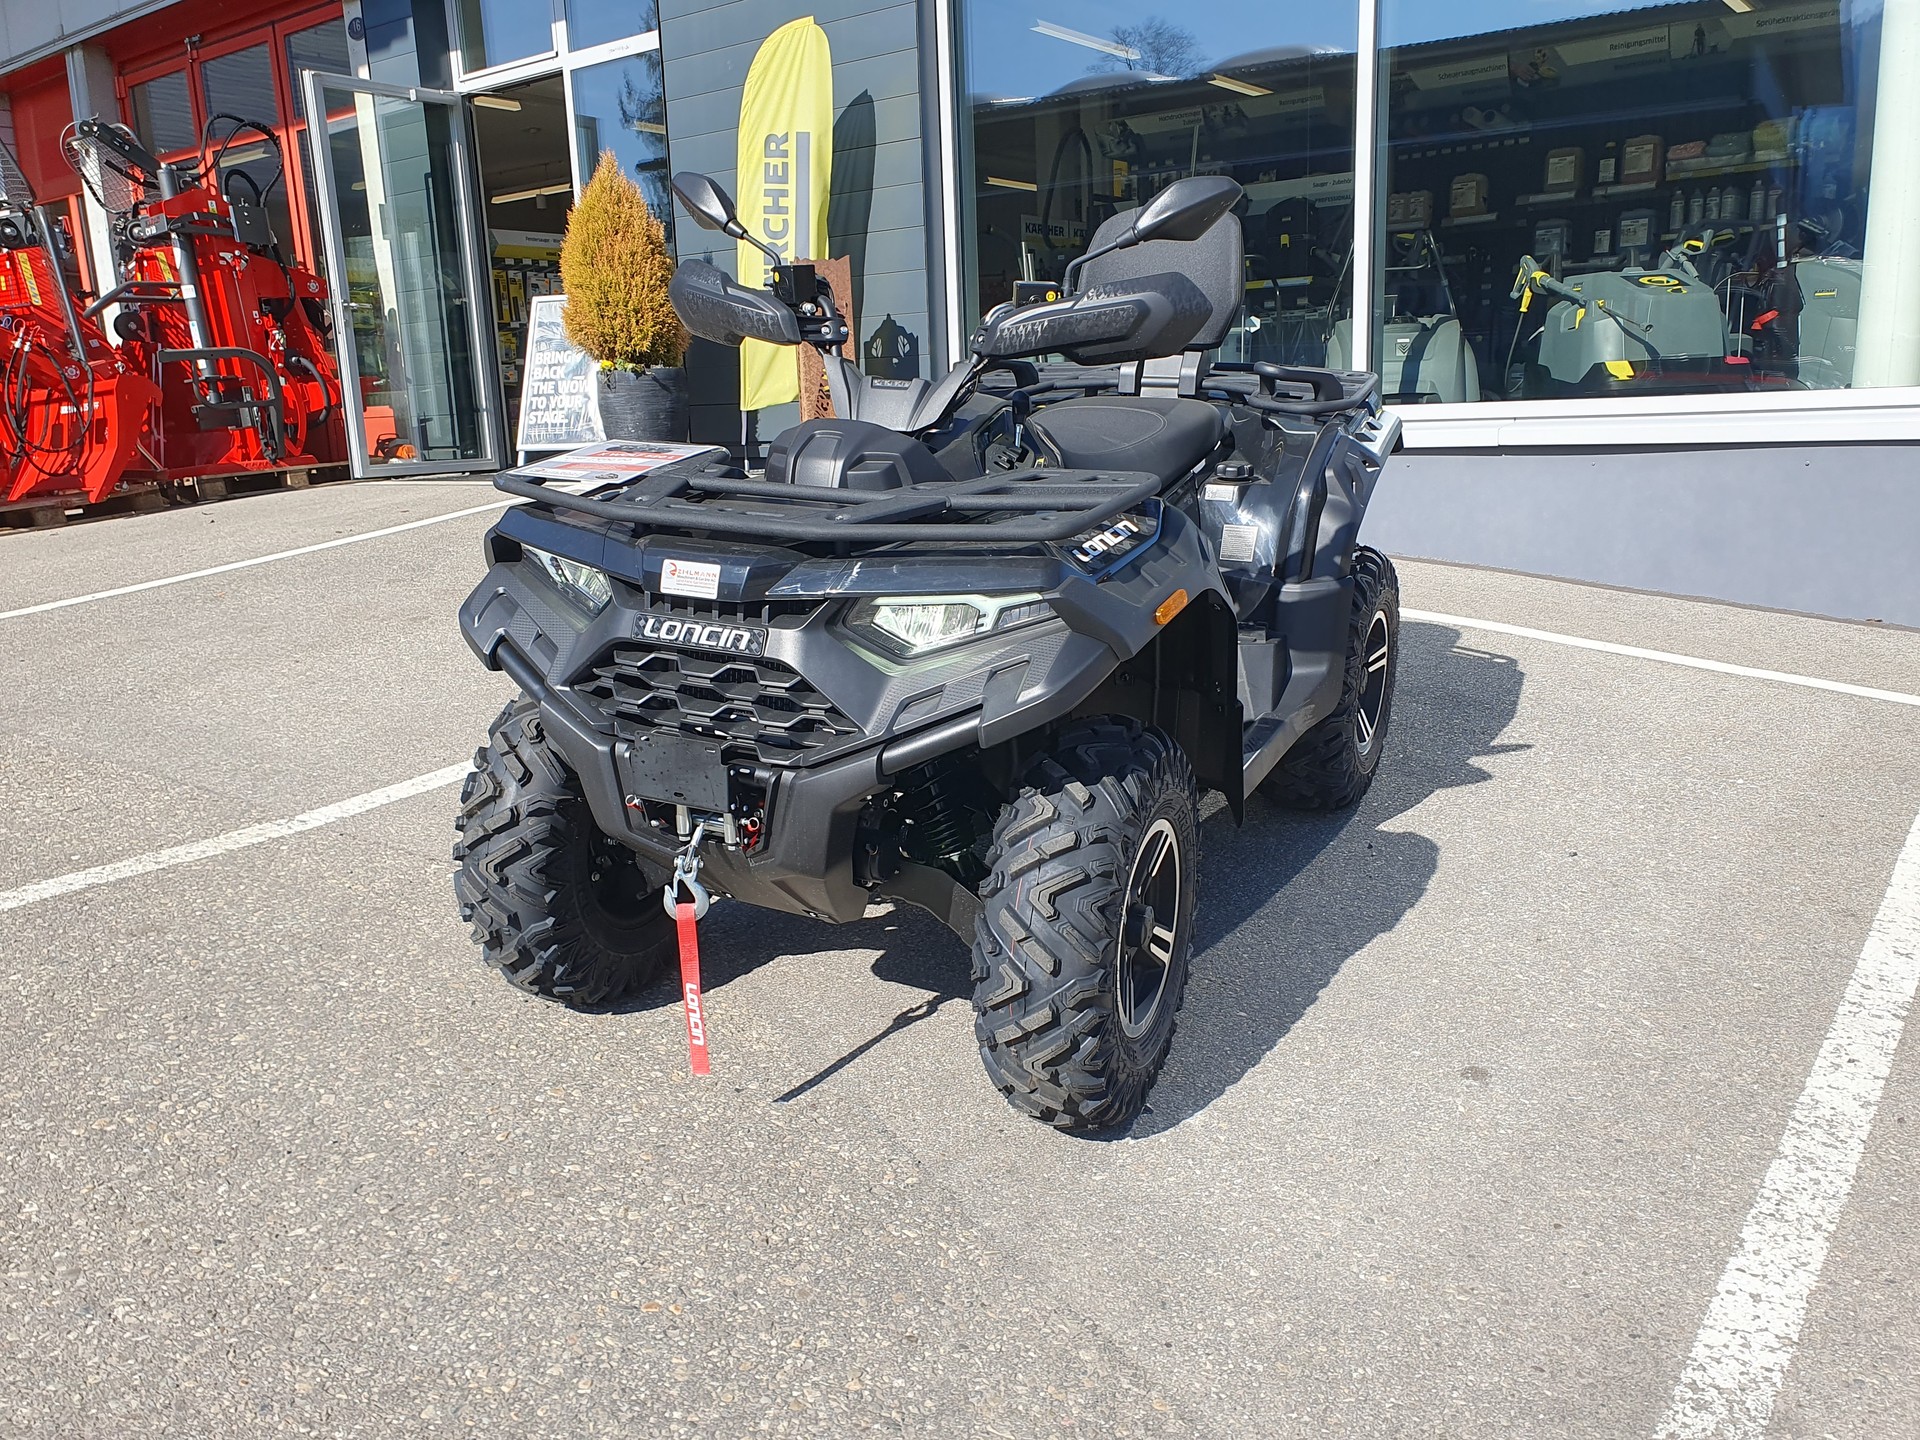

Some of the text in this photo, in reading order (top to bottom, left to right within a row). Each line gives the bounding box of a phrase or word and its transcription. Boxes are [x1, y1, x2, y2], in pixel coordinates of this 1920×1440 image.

[352, 19, 361, 32] 16
[1609, 34, 1667, 51] Reinigungsmittel
[1438, 63, 1507, 81] Scheuersaugmaschinen
[535, 350, 573, 365] BRING
[533, 366, 566, 380] BACK
[532, 380, 588, 395] THE WOW
[530, 395, 583, 410] TO YOUR
[1071, 519, 1140, 563] LONCIN
[644, 618, 751, 651] LONCIN
[685, 982, 705, 1046] LONCIN
